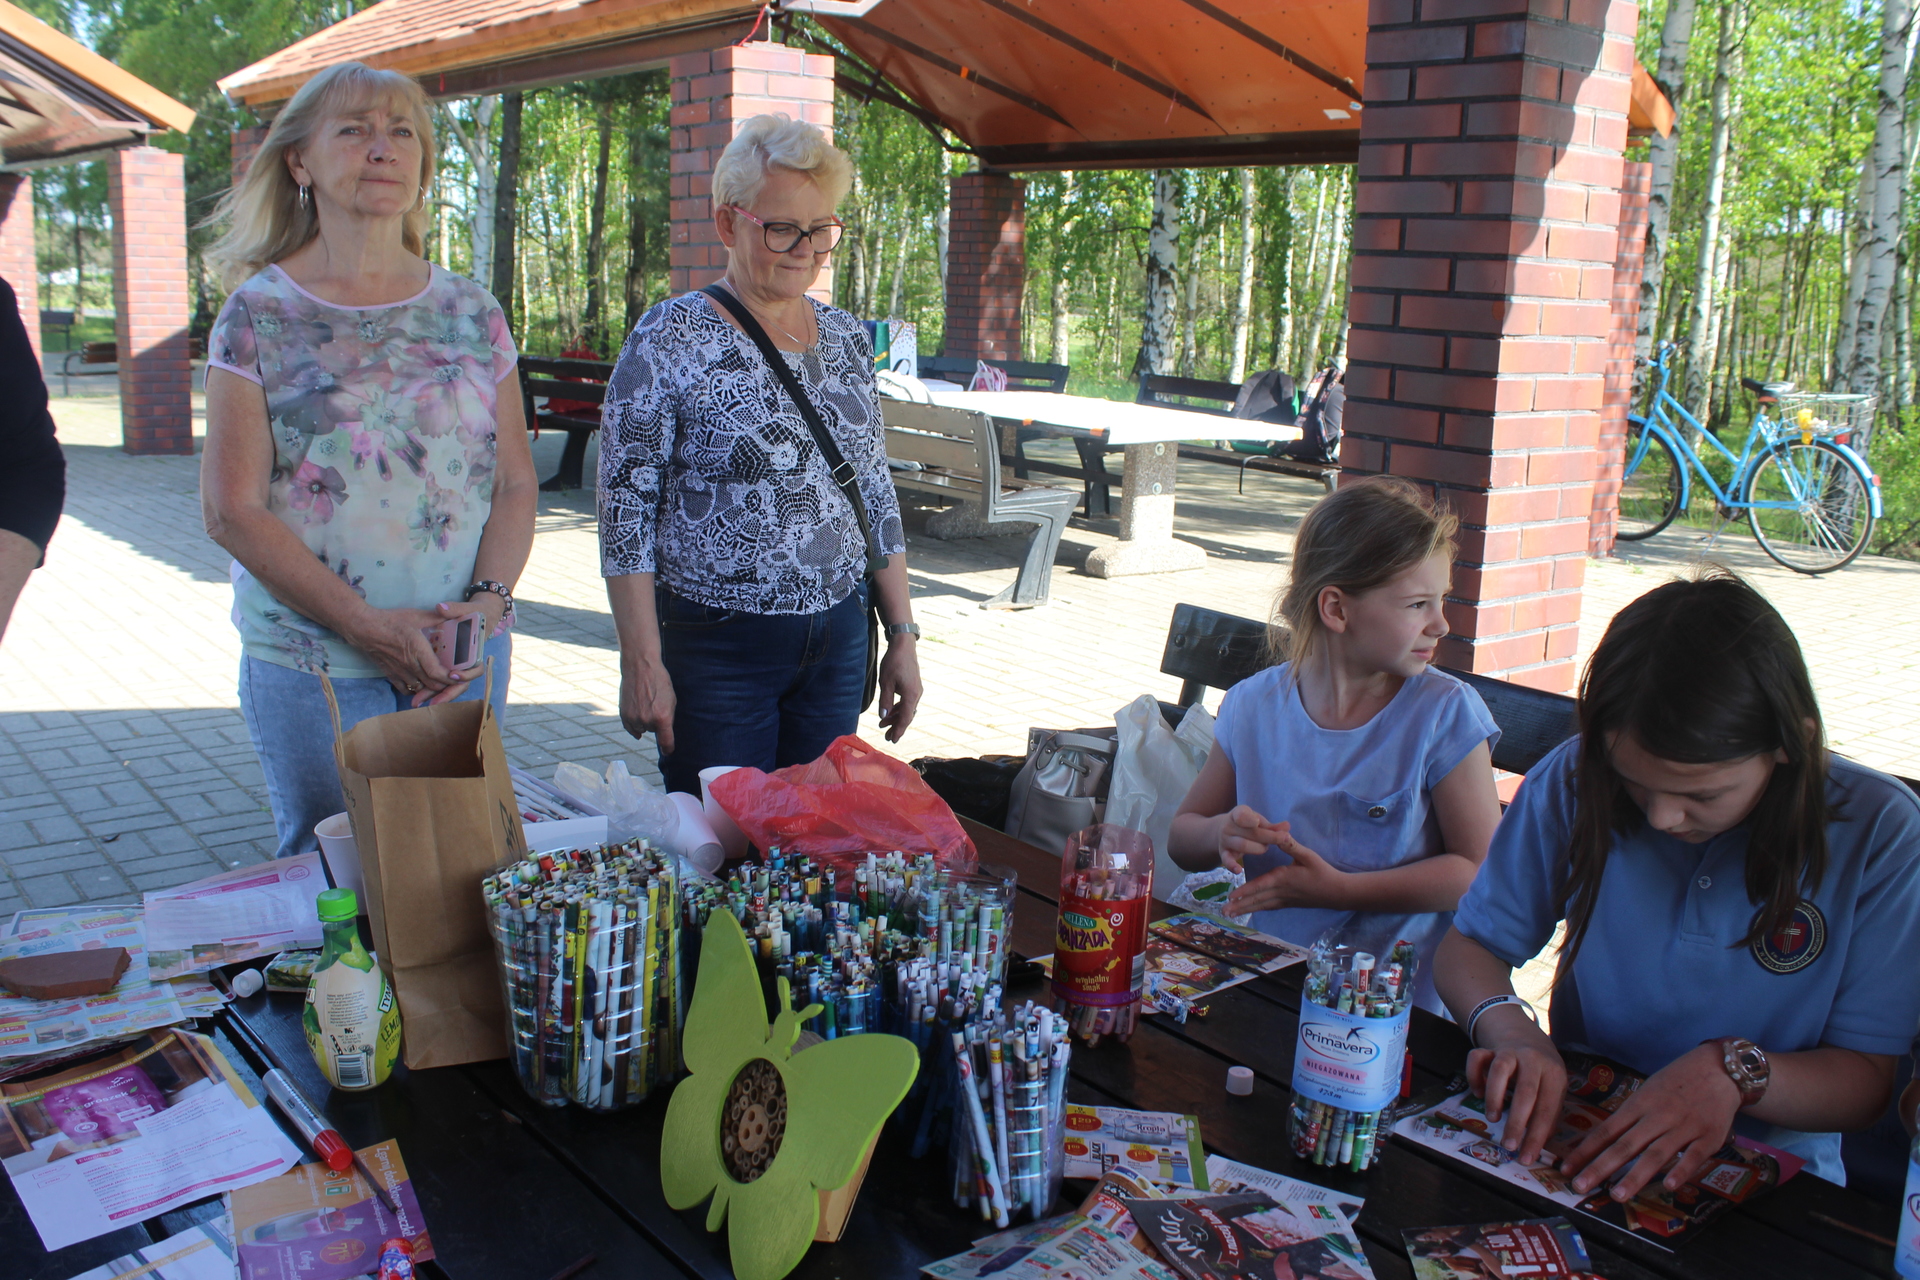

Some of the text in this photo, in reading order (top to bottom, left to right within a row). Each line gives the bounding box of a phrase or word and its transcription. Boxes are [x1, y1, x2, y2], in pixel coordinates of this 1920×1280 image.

[1064, 913, 1094, 927] HELLENA
[1083, 983, 1100, 991] smak
[156, 1036, 174, 1051] pieca
[1305, 1028, 1373, 1055] Primavera
[1307, 1060, 1360, 1080] NIEGAZOWANA
[107, 1078, 134, 1090] TAURON
[63, 1091, 129, 1113] ekogroszek
[372, 1144, 415, 1238] Zgarnij dodatkowe znaczki!
[1104, 1199, 1121, 1212] KUP
